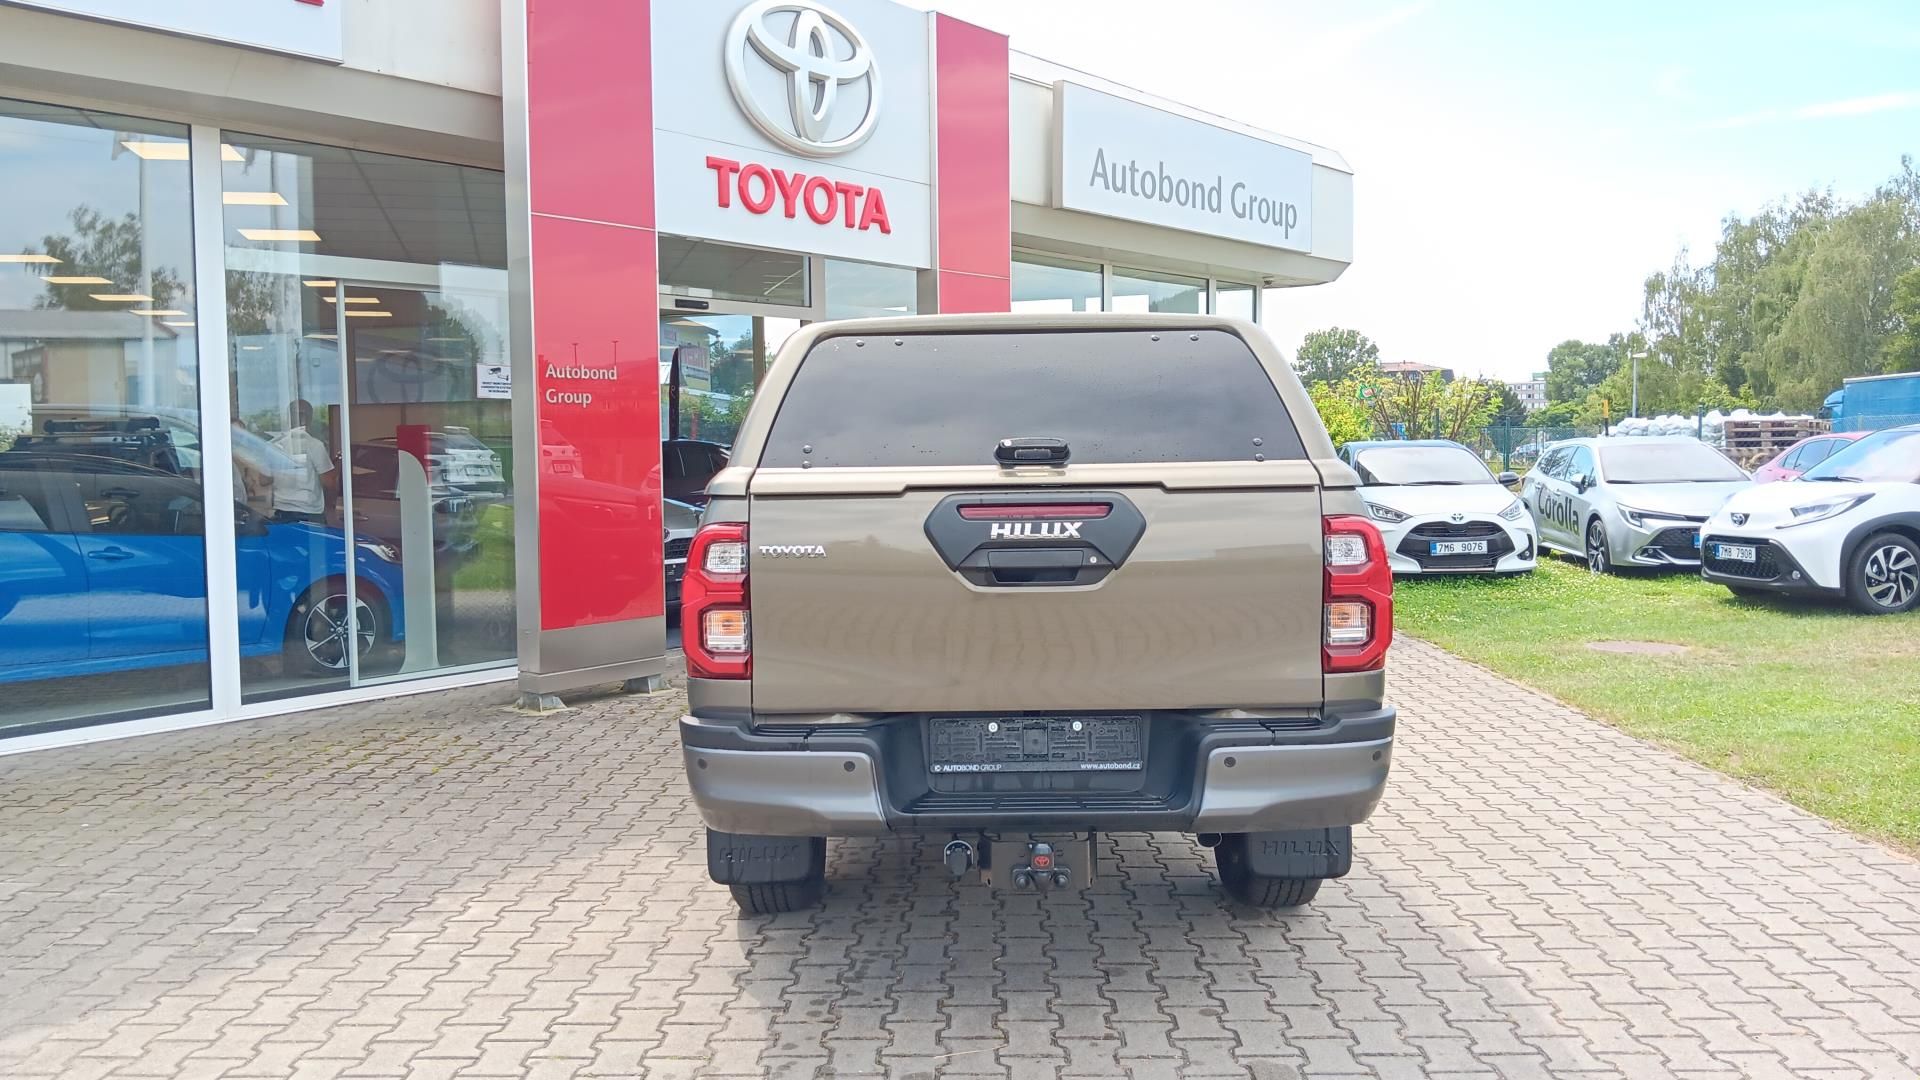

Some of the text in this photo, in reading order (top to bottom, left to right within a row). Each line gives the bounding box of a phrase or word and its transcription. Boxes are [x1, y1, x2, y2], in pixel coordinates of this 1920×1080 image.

[706, 155, 891, 235] TOYOTA
[1089, 147, 1298, 240] Autobond Group
[545, 363, 618, 380] Autobond
[545, 388, 592, 408] Group
[1538, 484, 1580, 536] Corolla
[990, 521, 1083, 540] HILUX
[758, 545, 827, 559] TOYOTA
[1438, 542, 1483, 553] 7M6 9076
[943, 763, 1002, 772] AUTOBOND GROUP
[1080, 761, 1141, 770] www.autobond.cz
[1261, 840, 1341, 857] HILUX
